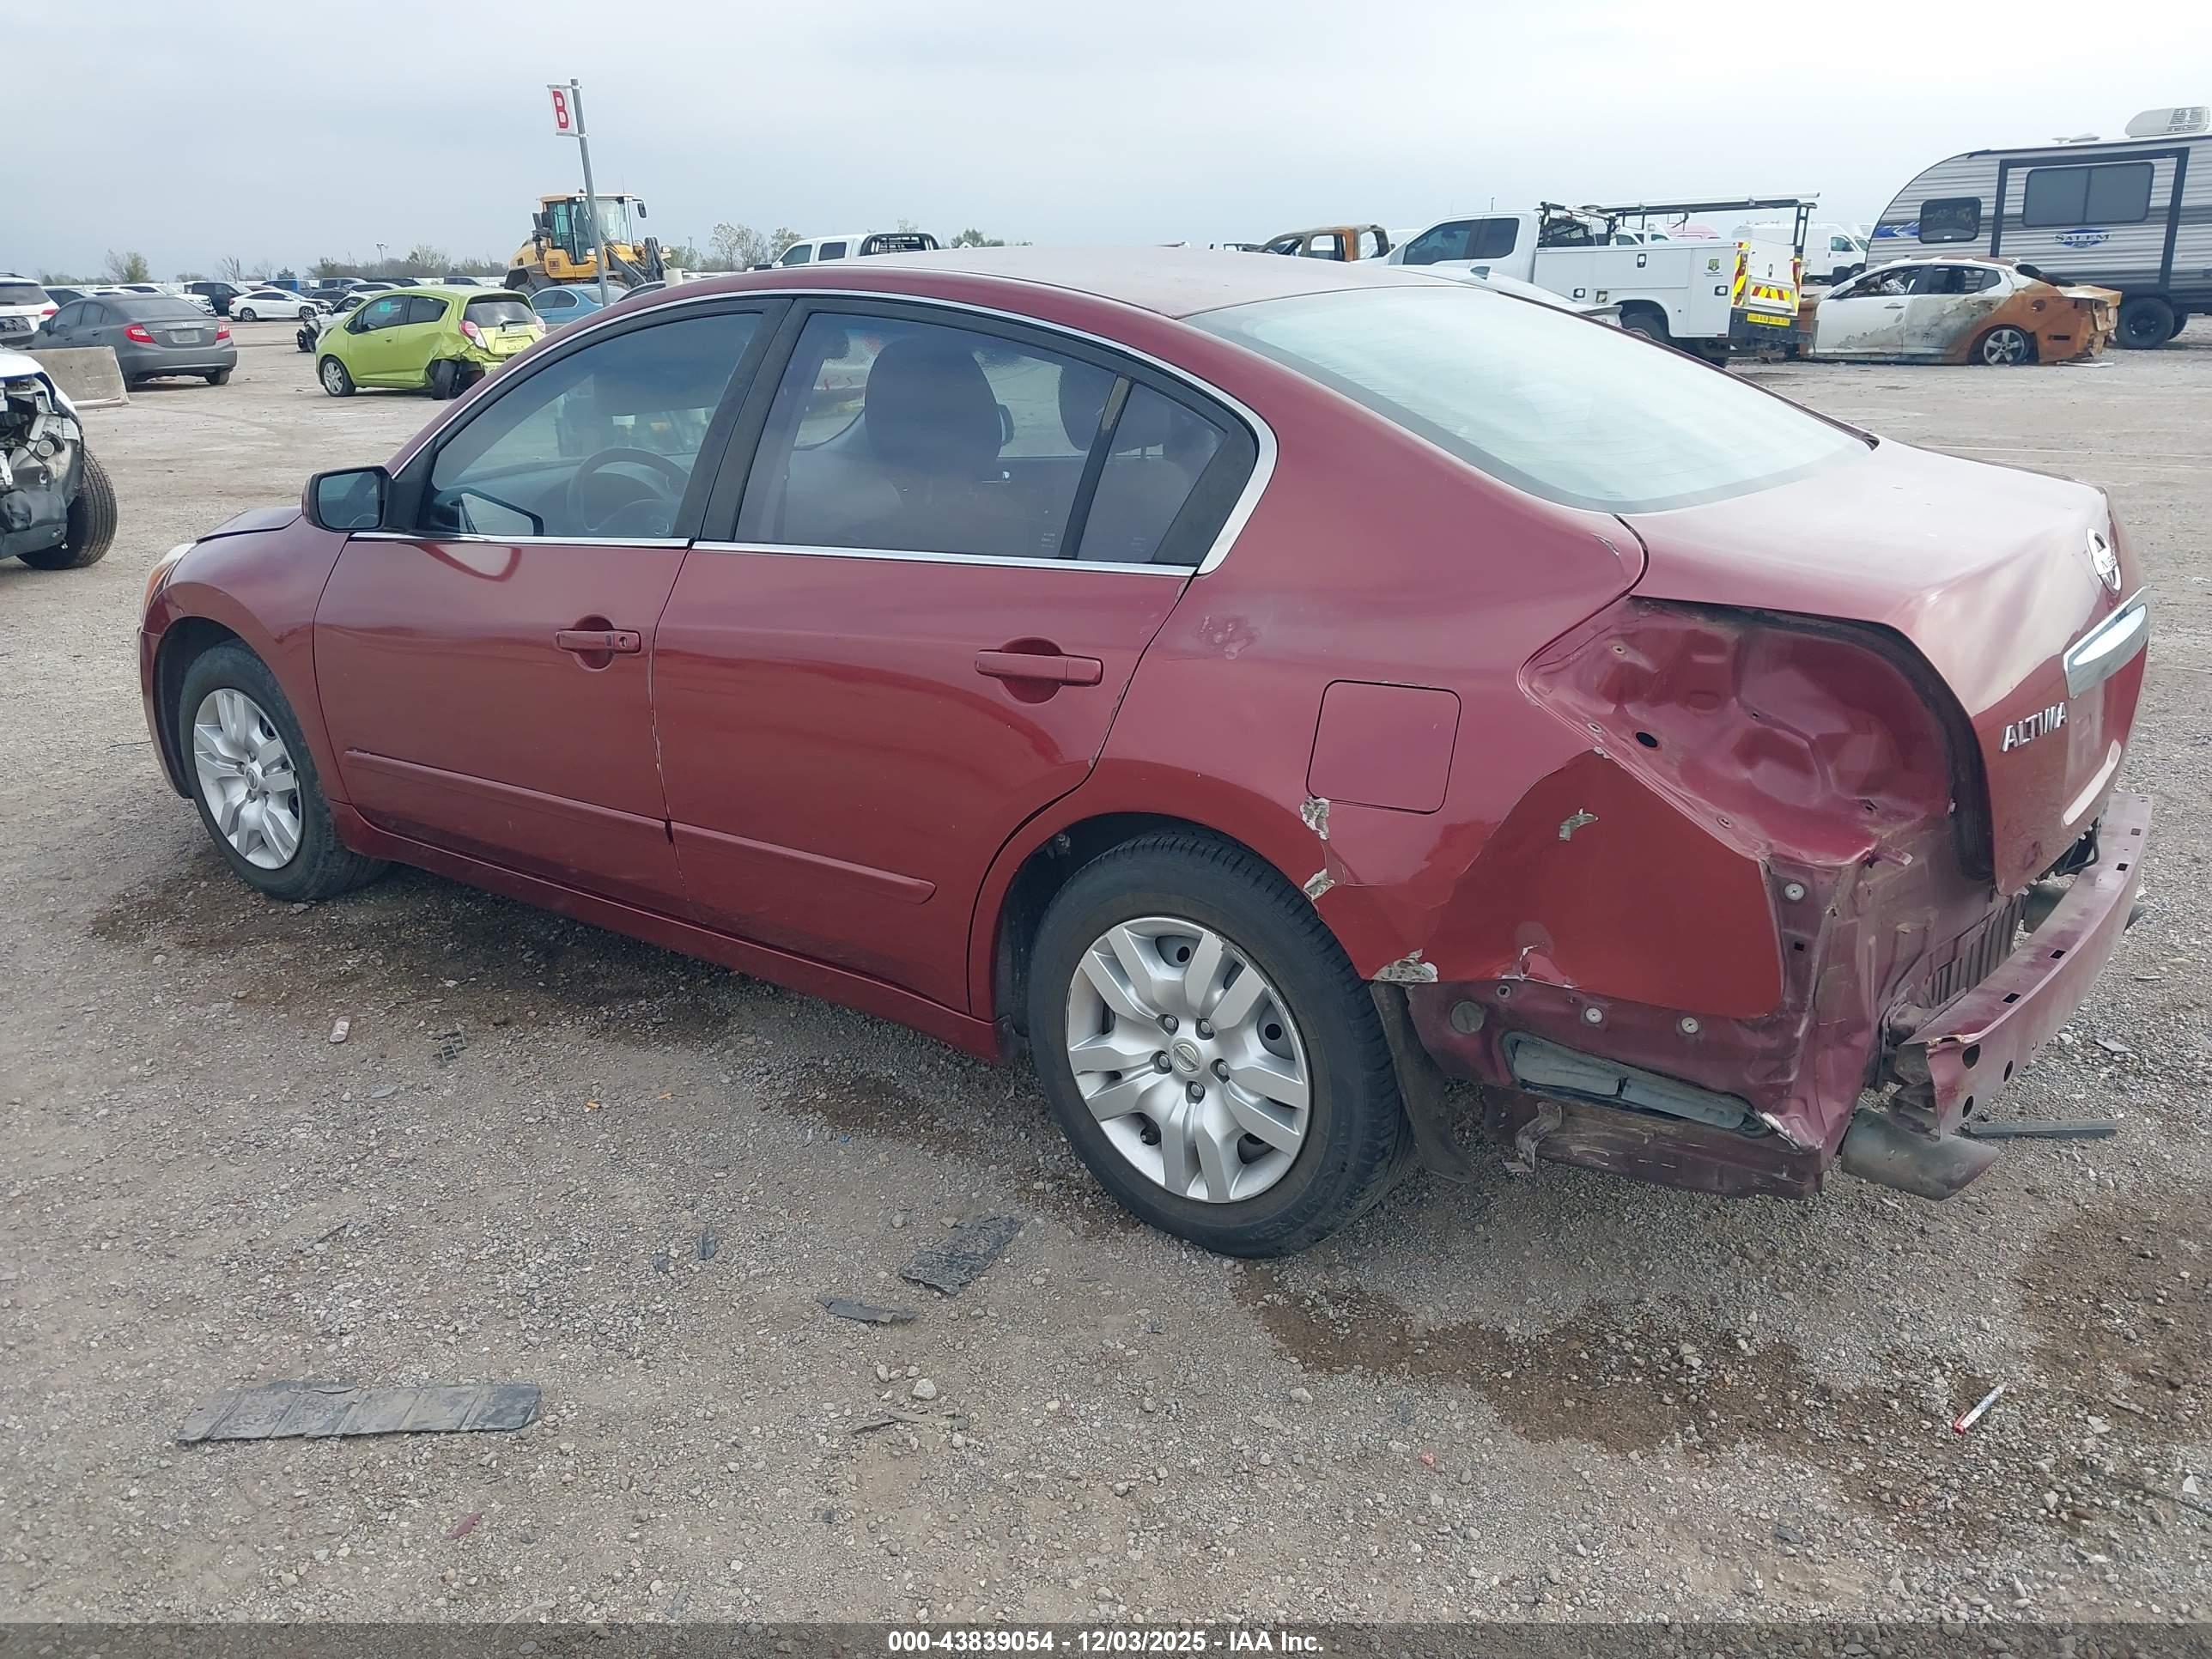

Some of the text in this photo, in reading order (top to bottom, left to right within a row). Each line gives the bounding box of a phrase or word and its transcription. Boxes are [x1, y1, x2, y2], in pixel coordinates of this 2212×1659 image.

[552, 90, 569, 129] B
[2054, 233, 2111, 242] SALEM
[1999, 701, 2068, 752] ALTIMA
